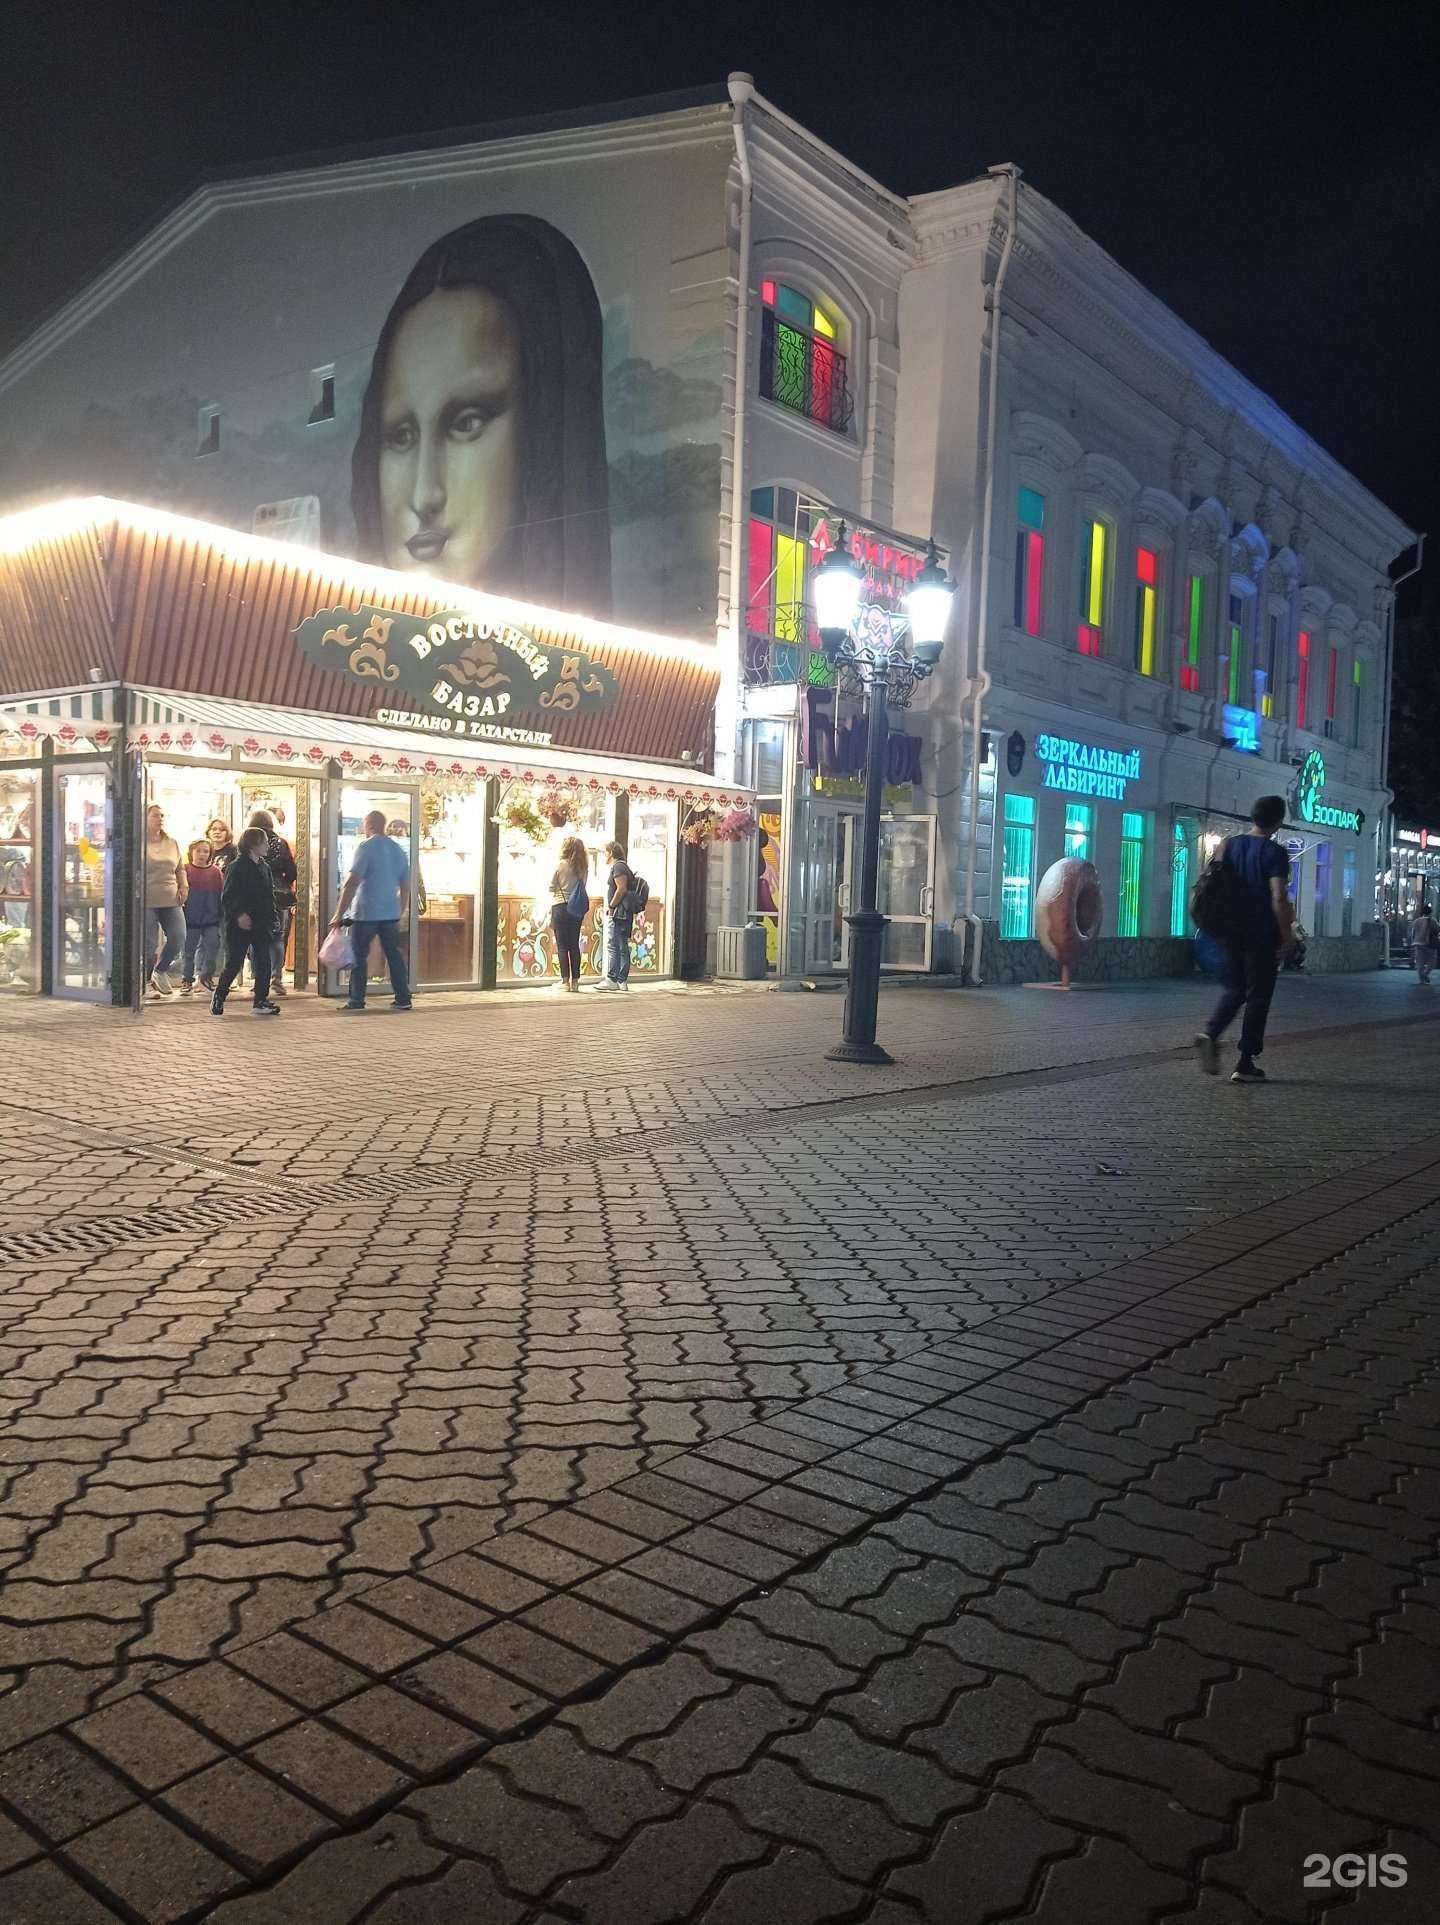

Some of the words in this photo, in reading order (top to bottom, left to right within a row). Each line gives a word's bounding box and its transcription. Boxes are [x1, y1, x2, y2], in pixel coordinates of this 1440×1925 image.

[409, 617, 550, 680] ВОСТОЧНЫЙ
[430, 680, 511, 716] БАЗАР
[376, 708, 452, 732] СДЕЛАНО
[454, 719, 466, 734] В
[470, 721, 553, 746] ТАТАРСТАНЕ
[1037, 734, 1140, 780] ЗЕРКАЛЬНЫЙ
[1043, 763, 1127, 800] ЛАБИРИНТ
[1313, 804, 1360, 833] ЗООПАРК
